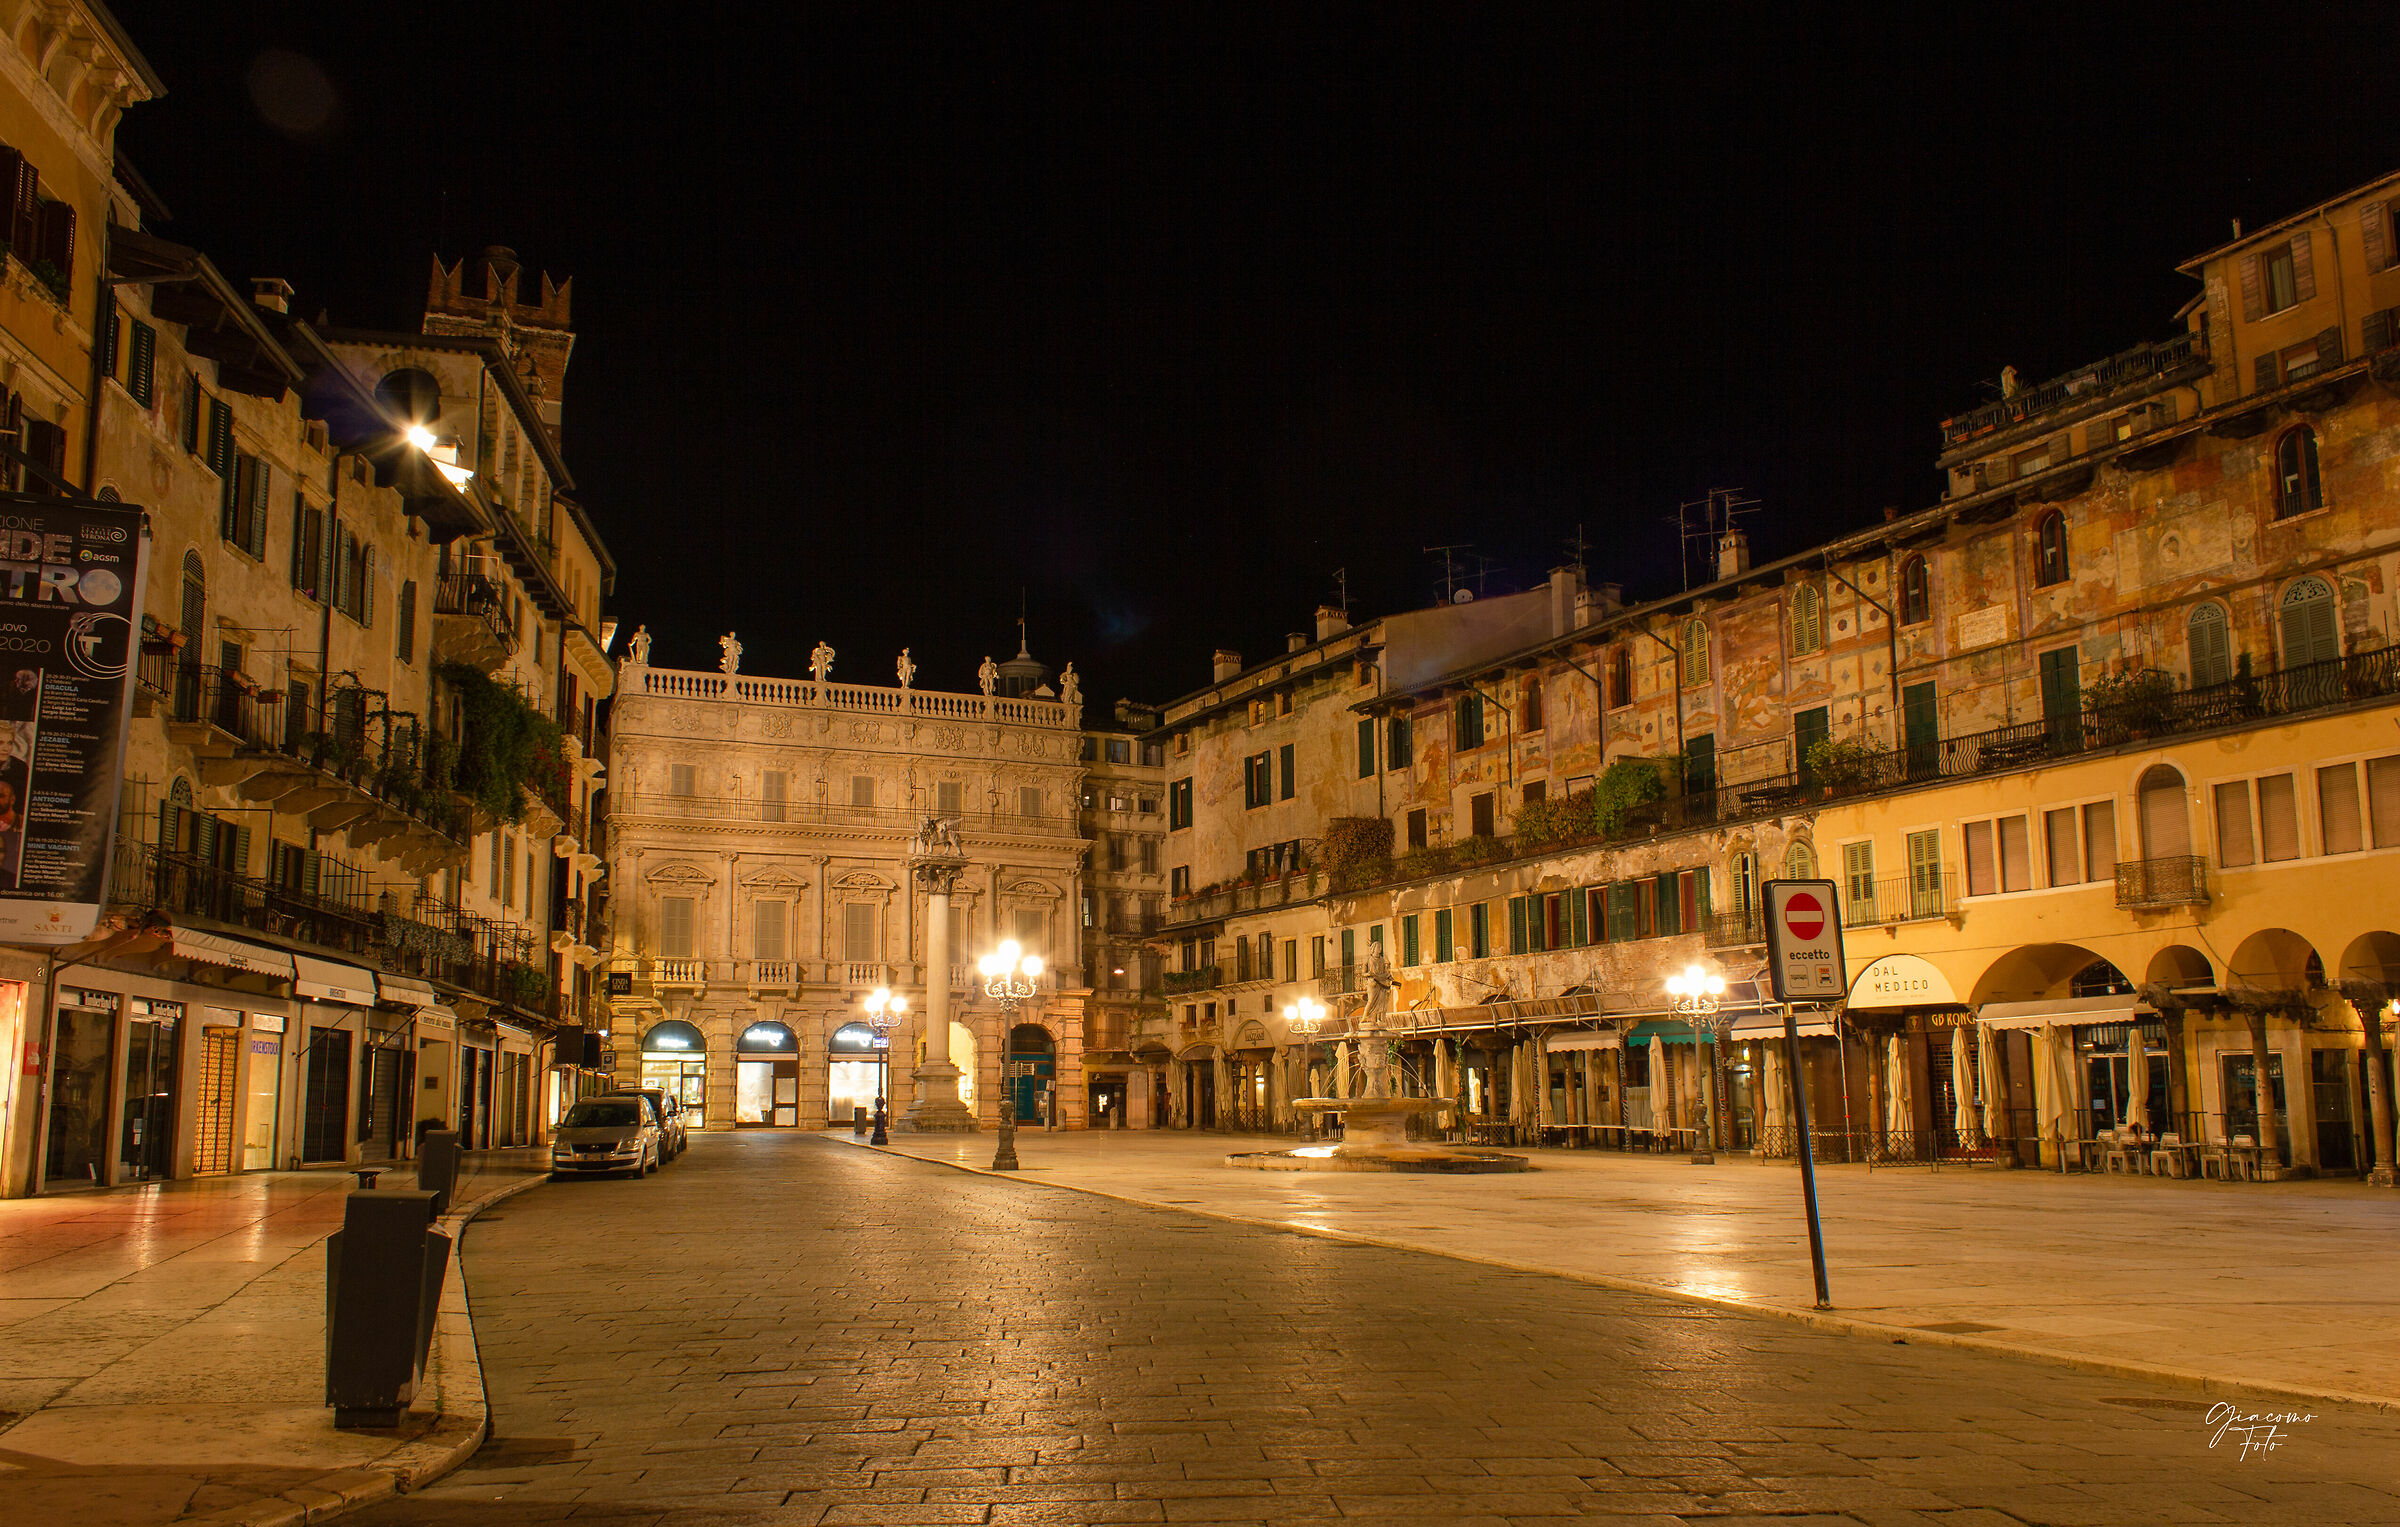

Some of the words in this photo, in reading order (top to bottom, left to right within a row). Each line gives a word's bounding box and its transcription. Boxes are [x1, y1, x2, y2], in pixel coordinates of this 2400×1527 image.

[0, 515, 45, 532] IONE
[39, 736, 70, 744] JEZABEL
[32, 796, 70, 804] ANTIGONE
[27, 842, 46, 850] MINE
[0, 889, 33, 897] domenica
[34, 923, 72, 933] SANTI
[1789, 948, 1831, 960] eccetto
[36, 966, 46, 977] 21
[1873, 966, 1899, 977] DAL
[1874, 979, 1929, 993] MEDICO
[1931, 1014, 1945, 1027] GB
